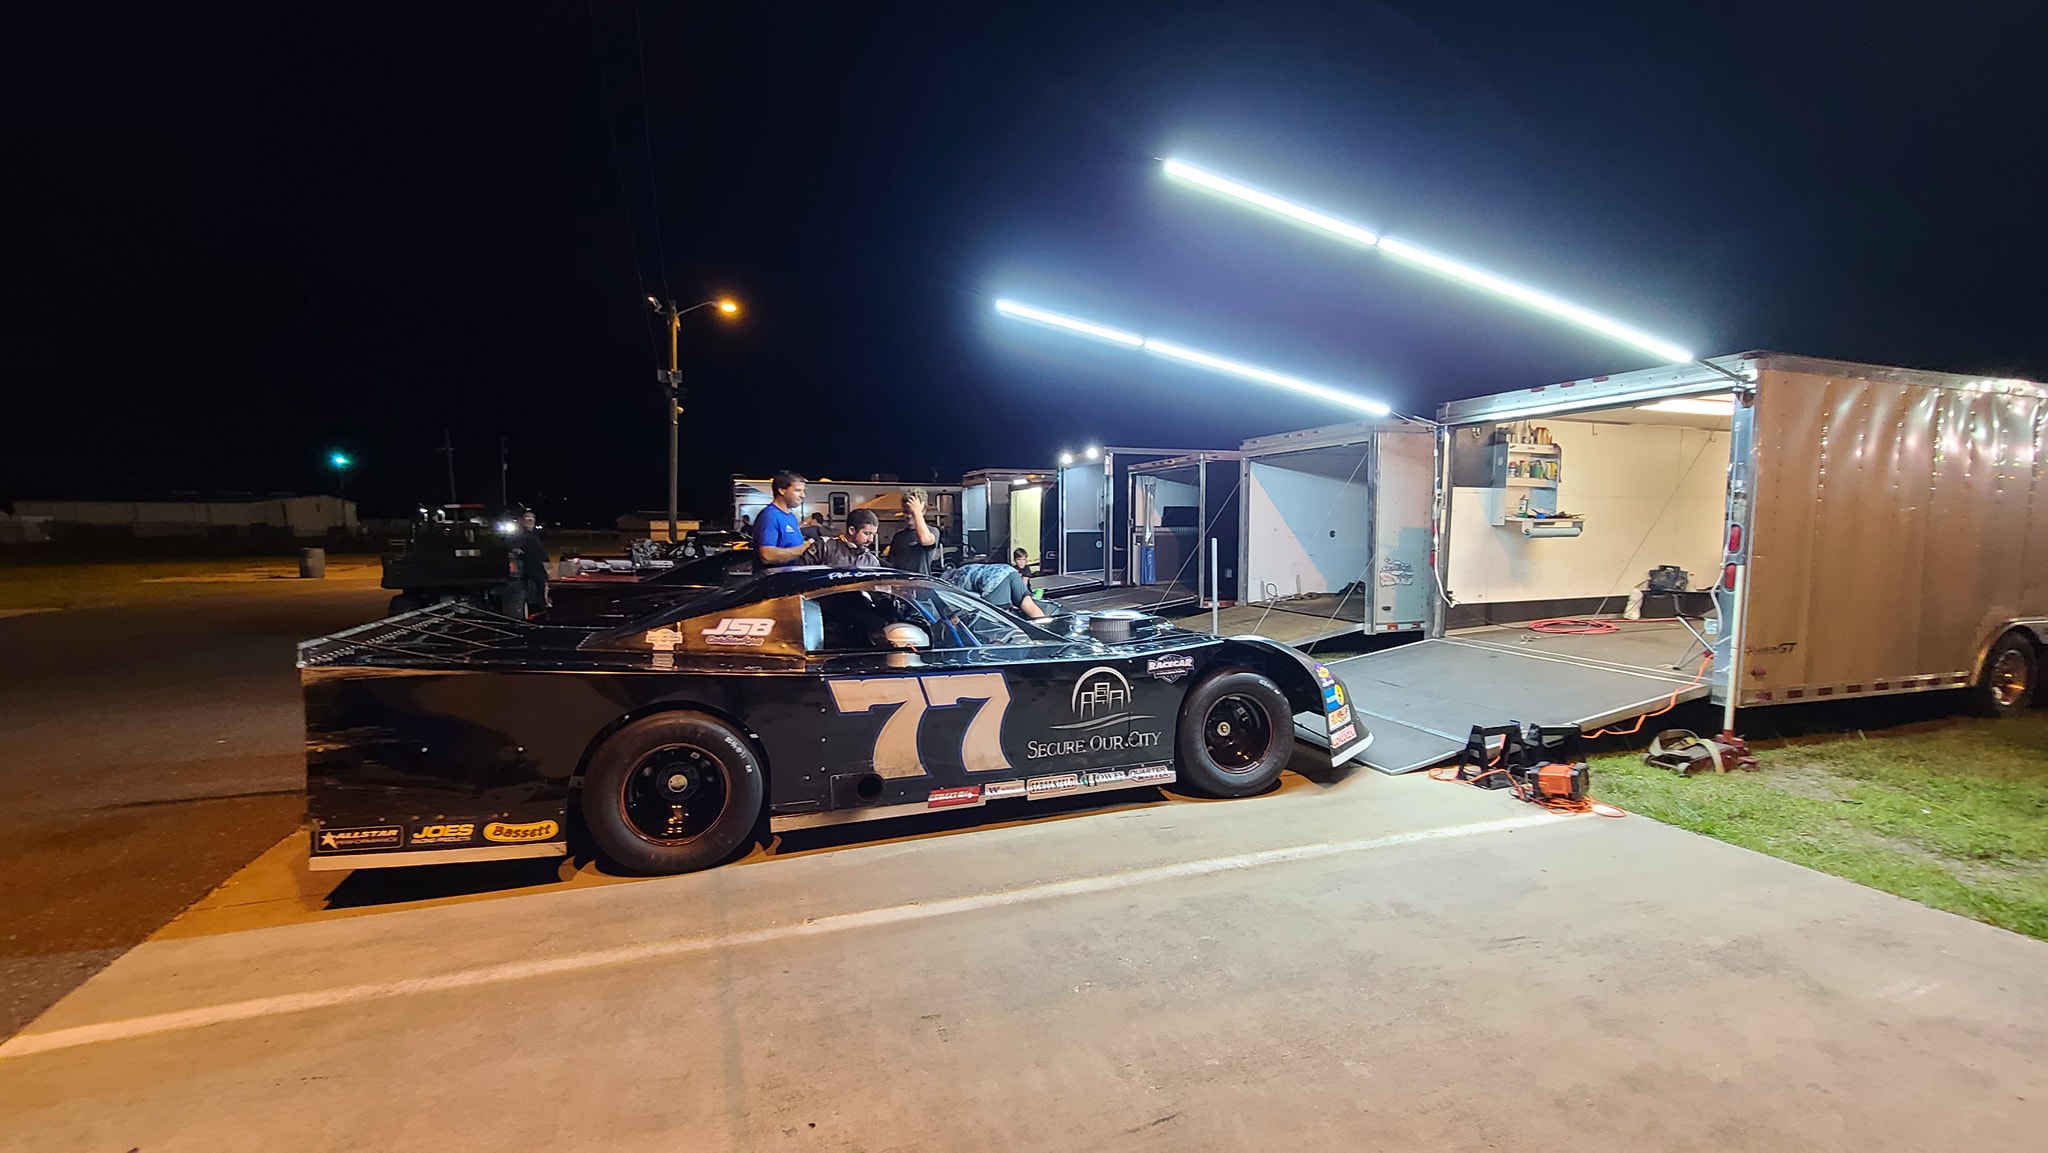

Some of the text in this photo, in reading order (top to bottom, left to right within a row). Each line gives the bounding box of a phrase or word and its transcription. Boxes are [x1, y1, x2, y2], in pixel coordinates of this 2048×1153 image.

[701, 618, 776, 636] JSB
[1149, 658, 1193, 671] RACECAR
[825, 671, 1013, 780] 77
[1027, 740, 1087, 759] SECURE
[334, 829, 399, 839] ALLSTAR
[413, 824, 475, 839] JOES
[493, 824, 551, 838] Bassett
